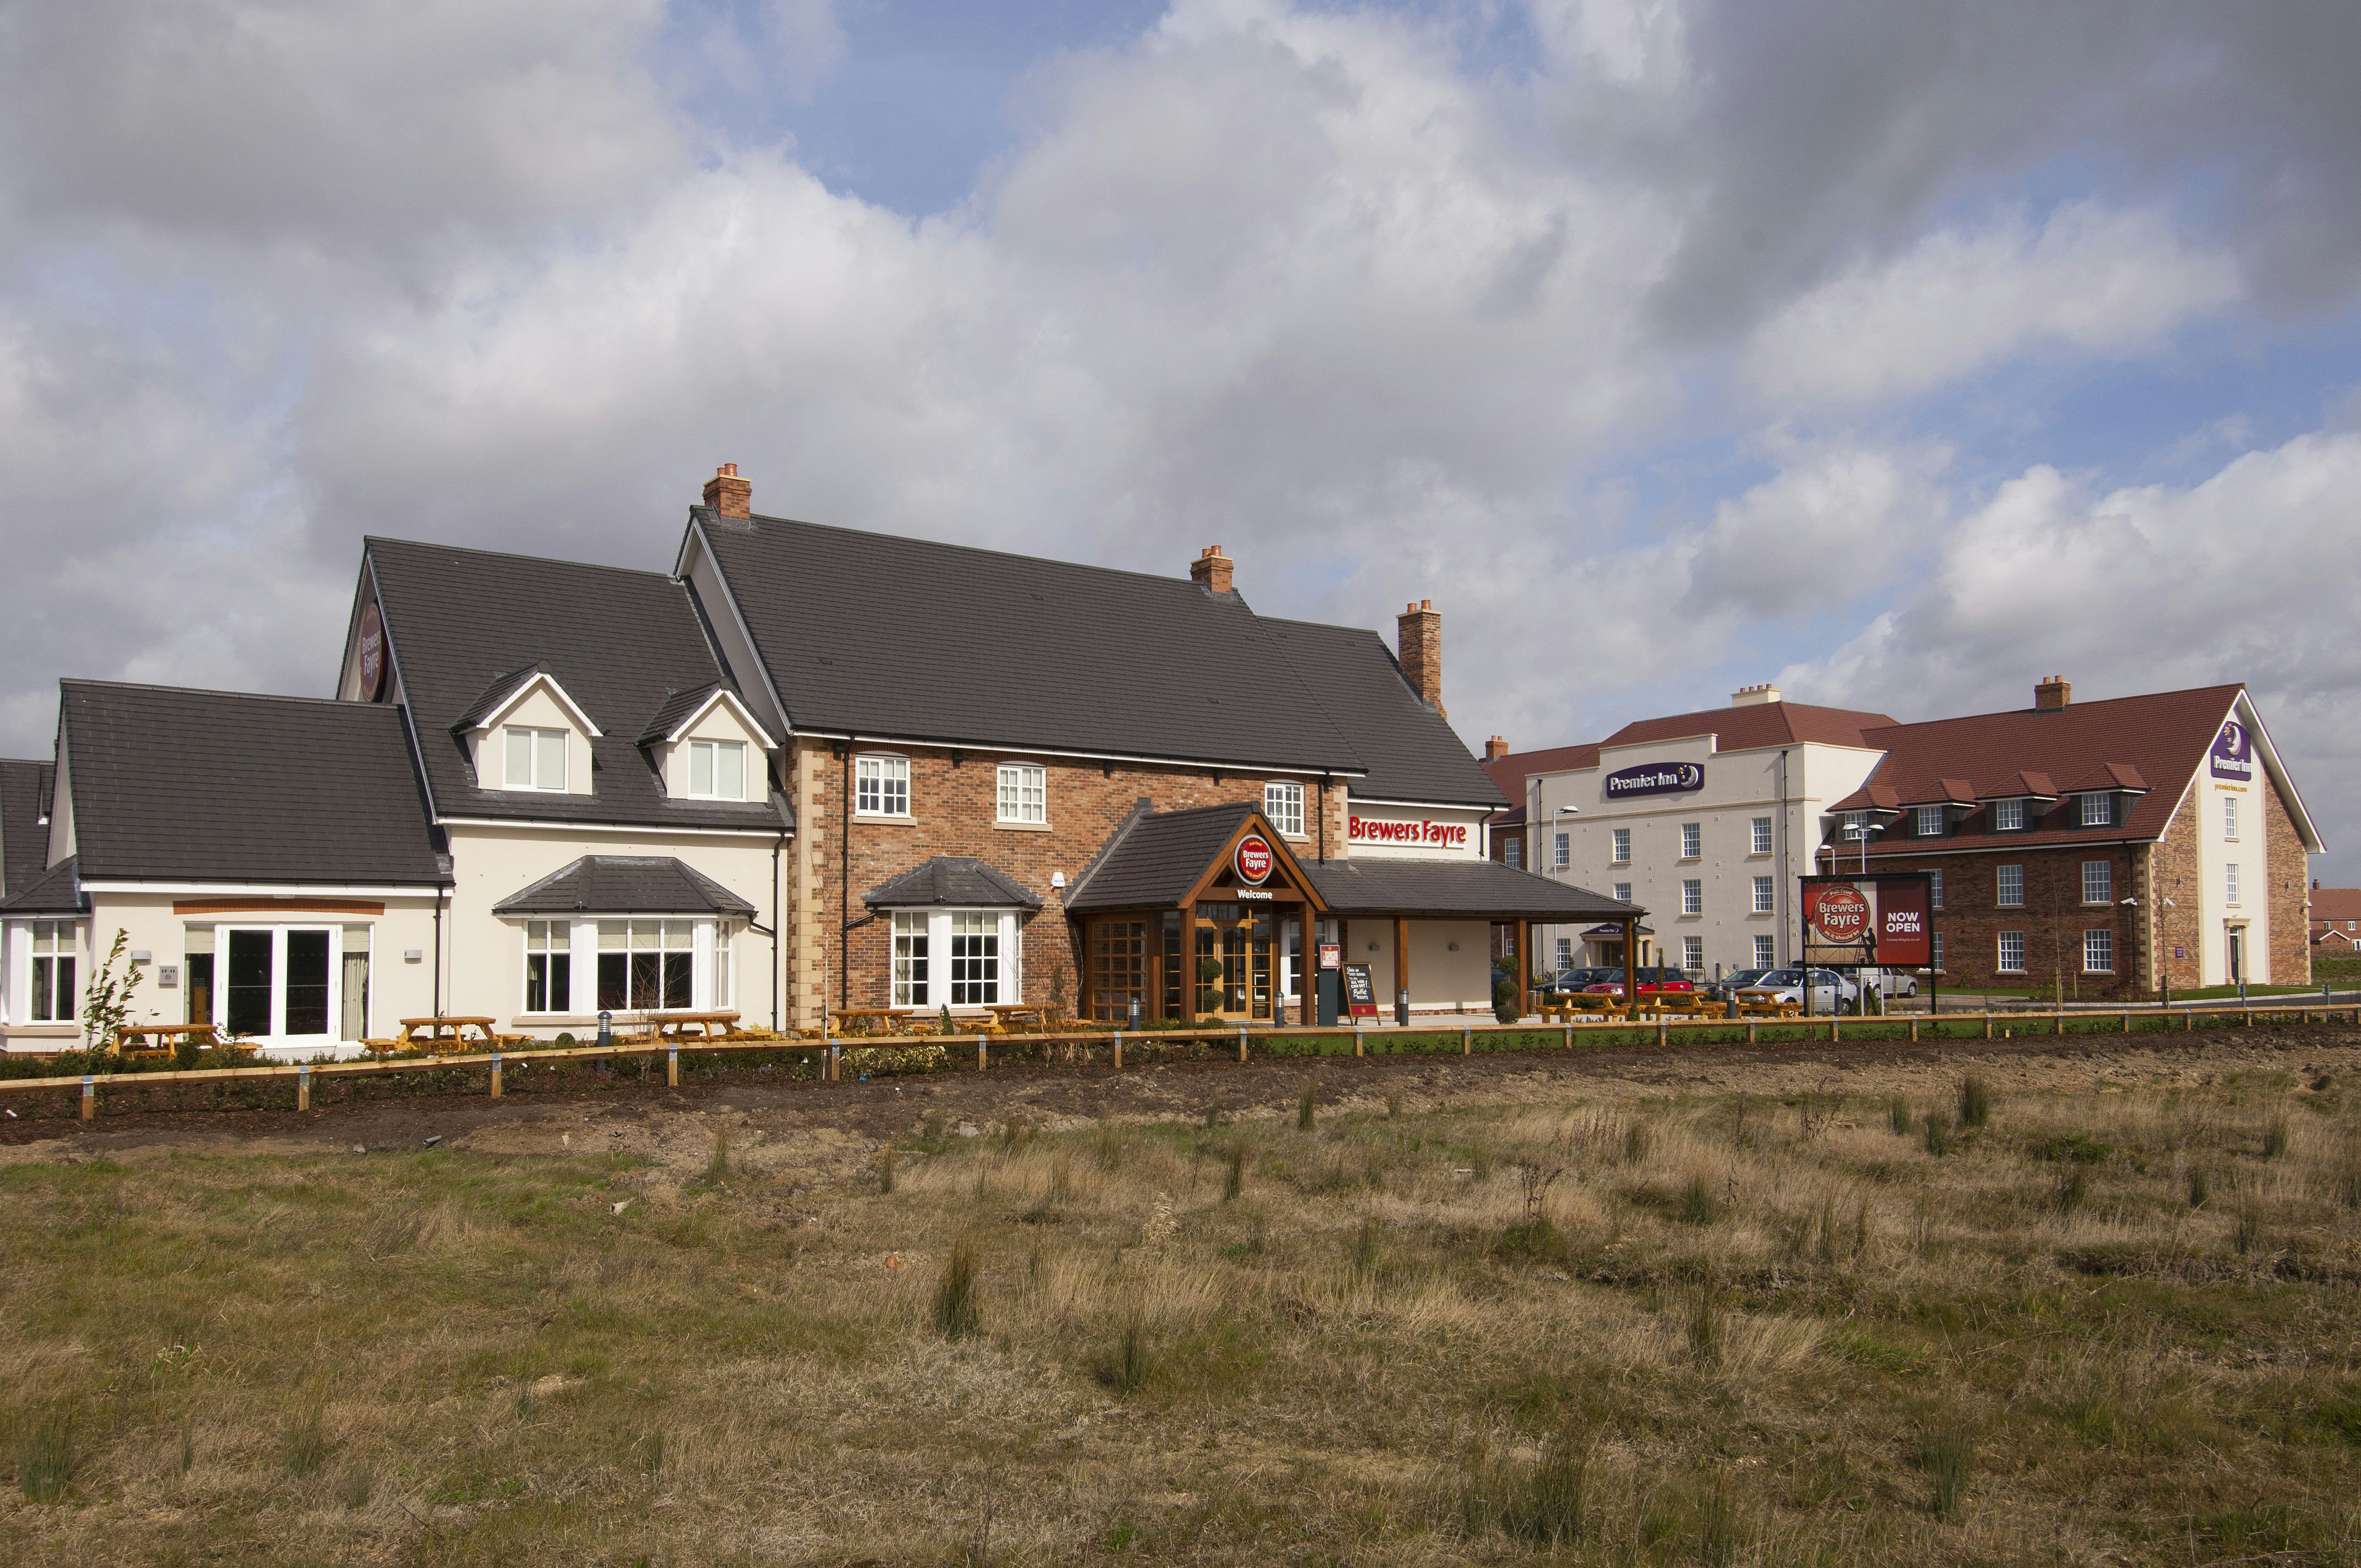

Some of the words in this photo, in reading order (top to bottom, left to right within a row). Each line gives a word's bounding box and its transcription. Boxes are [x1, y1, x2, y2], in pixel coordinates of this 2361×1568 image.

[362, 630, 380, 655] Brewers
[364, 650, 379, 678] Fayre
[2213, 755, 2241, 771] Premier
[2240, 759, 2251, 772] Inn
[1610, 774, 1657, 791] Premier
[1658, 772, 1678, 786] Inn
[1349, 816, 1420, 841] Brewers
[1422, 820, 1467, 848] Fayre
[1243, 850, 1269, 859] Brewers
[1245, 858, 1266, 870] Fayre
[1237, 889, 1272, 899] Welcome
[1819, 902, 1864, 913] Brewers
[1824, 913, 1860, 929] Fayre
[1887, 912, 1919, 922] NOW
[1886, 923, 1920, 933] OPEN
